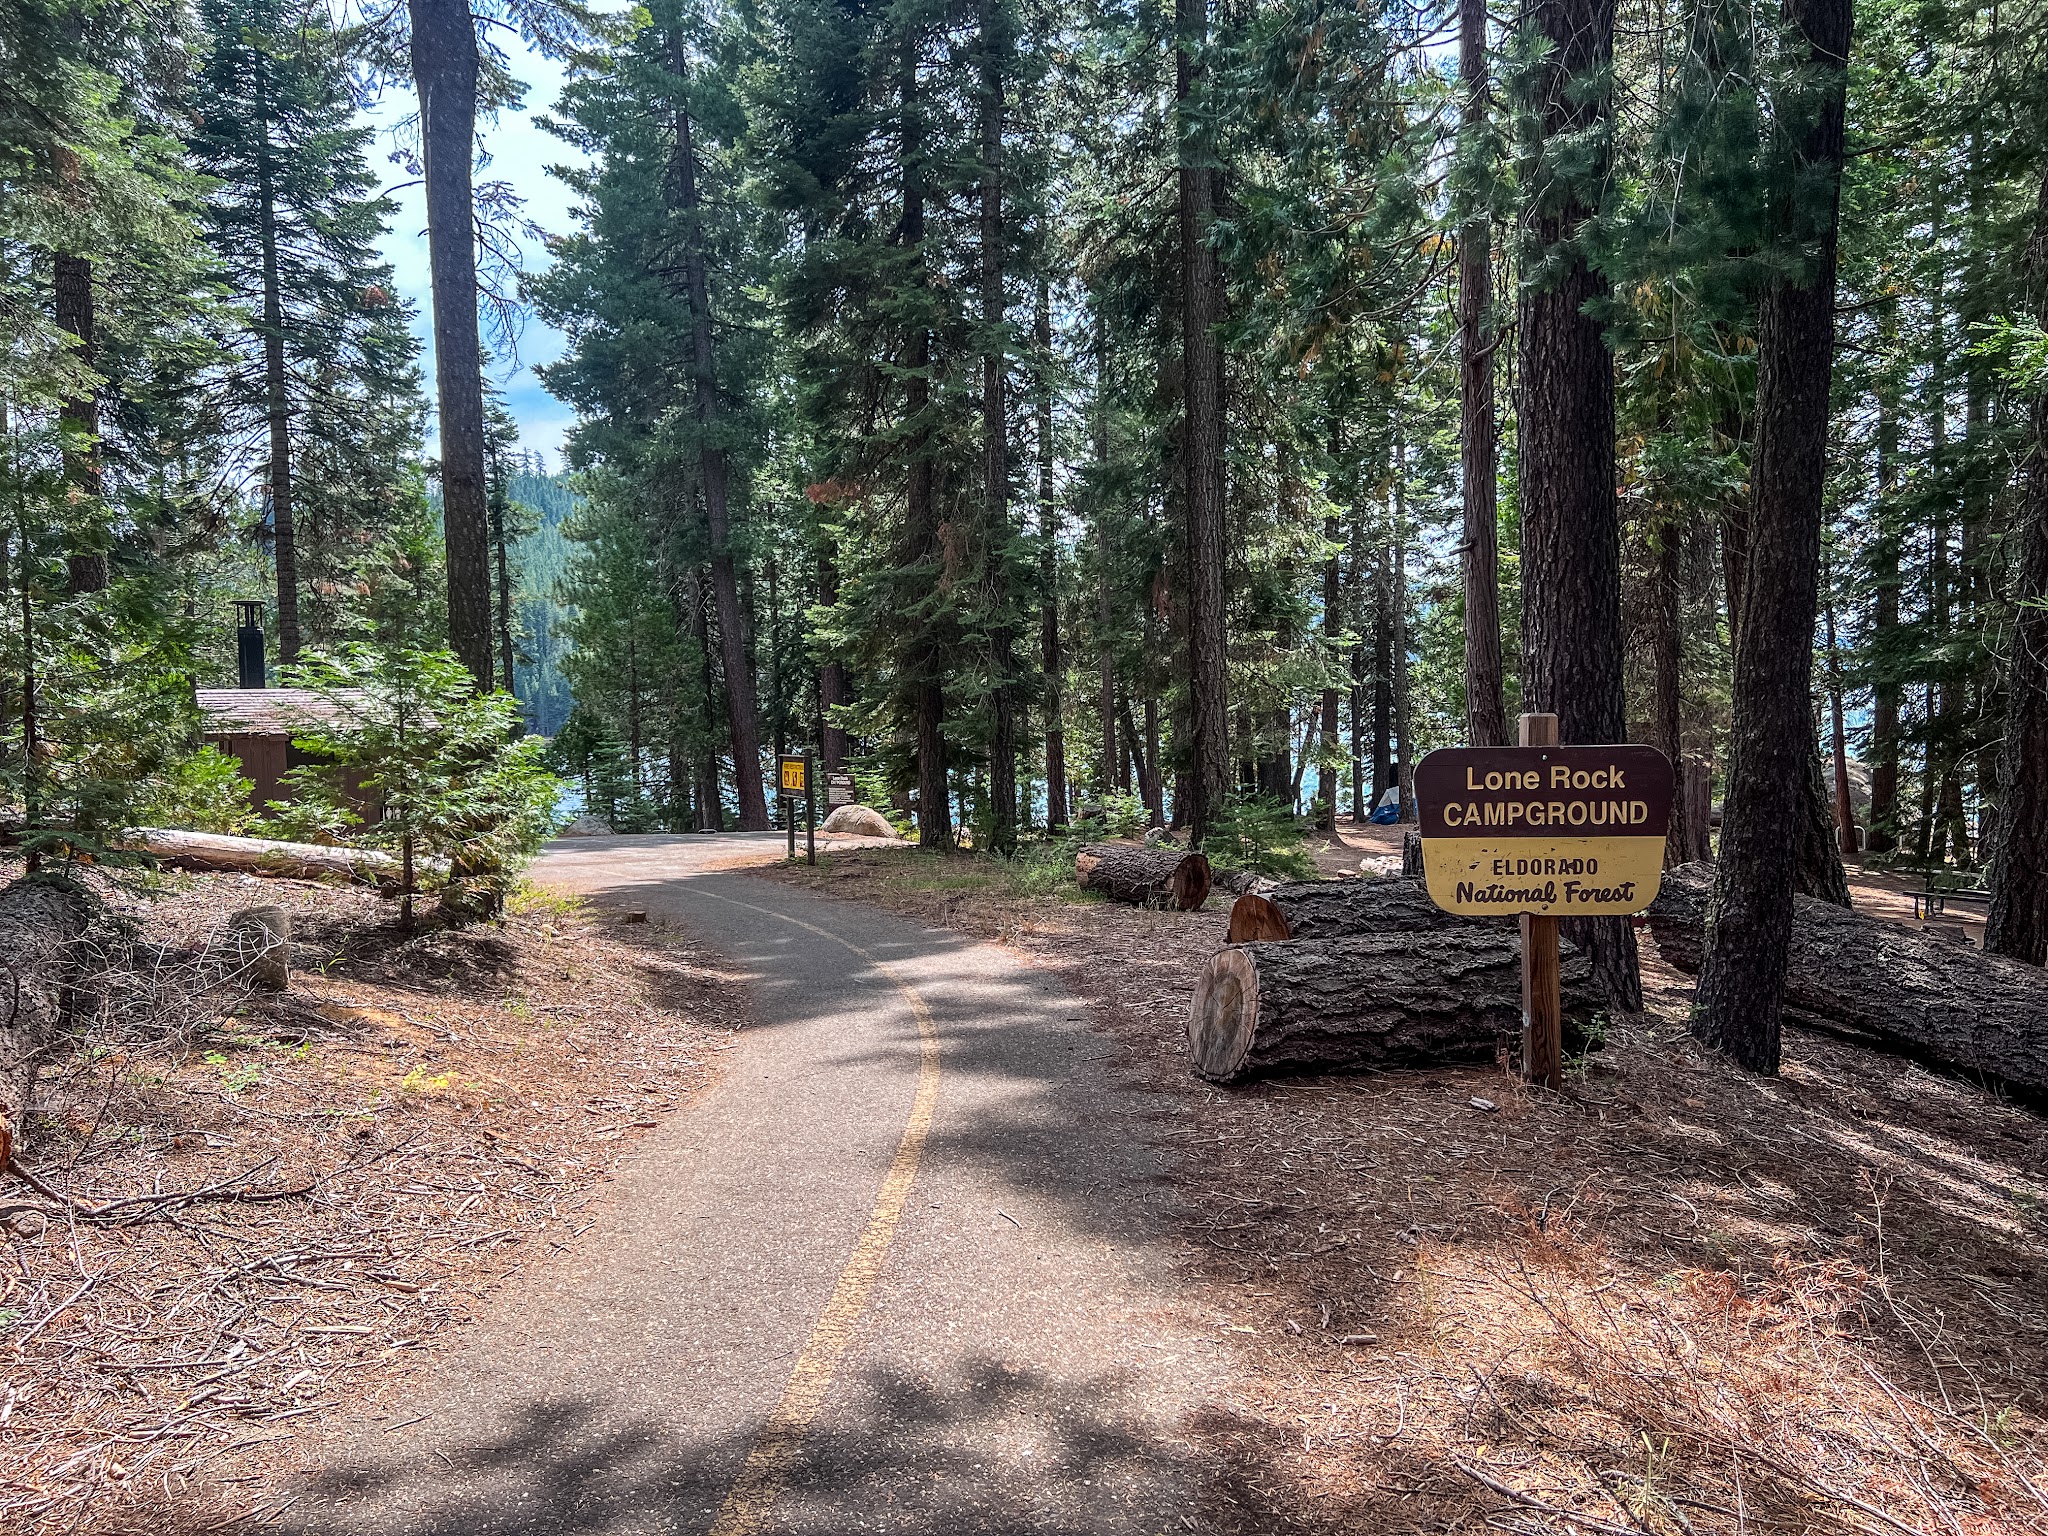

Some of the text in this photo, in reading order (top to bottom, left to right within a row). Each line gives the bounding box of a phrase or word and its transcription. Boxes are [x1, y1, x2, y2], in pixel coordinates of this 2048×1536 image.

[1466, 765, 1626, 790] Lone Rock
[1443, 800, 1648, 827] CAMPGROUND
[1493, 858, 1598, 876] ELDORADO
[1456, 880, 1635, 904] National Forest
